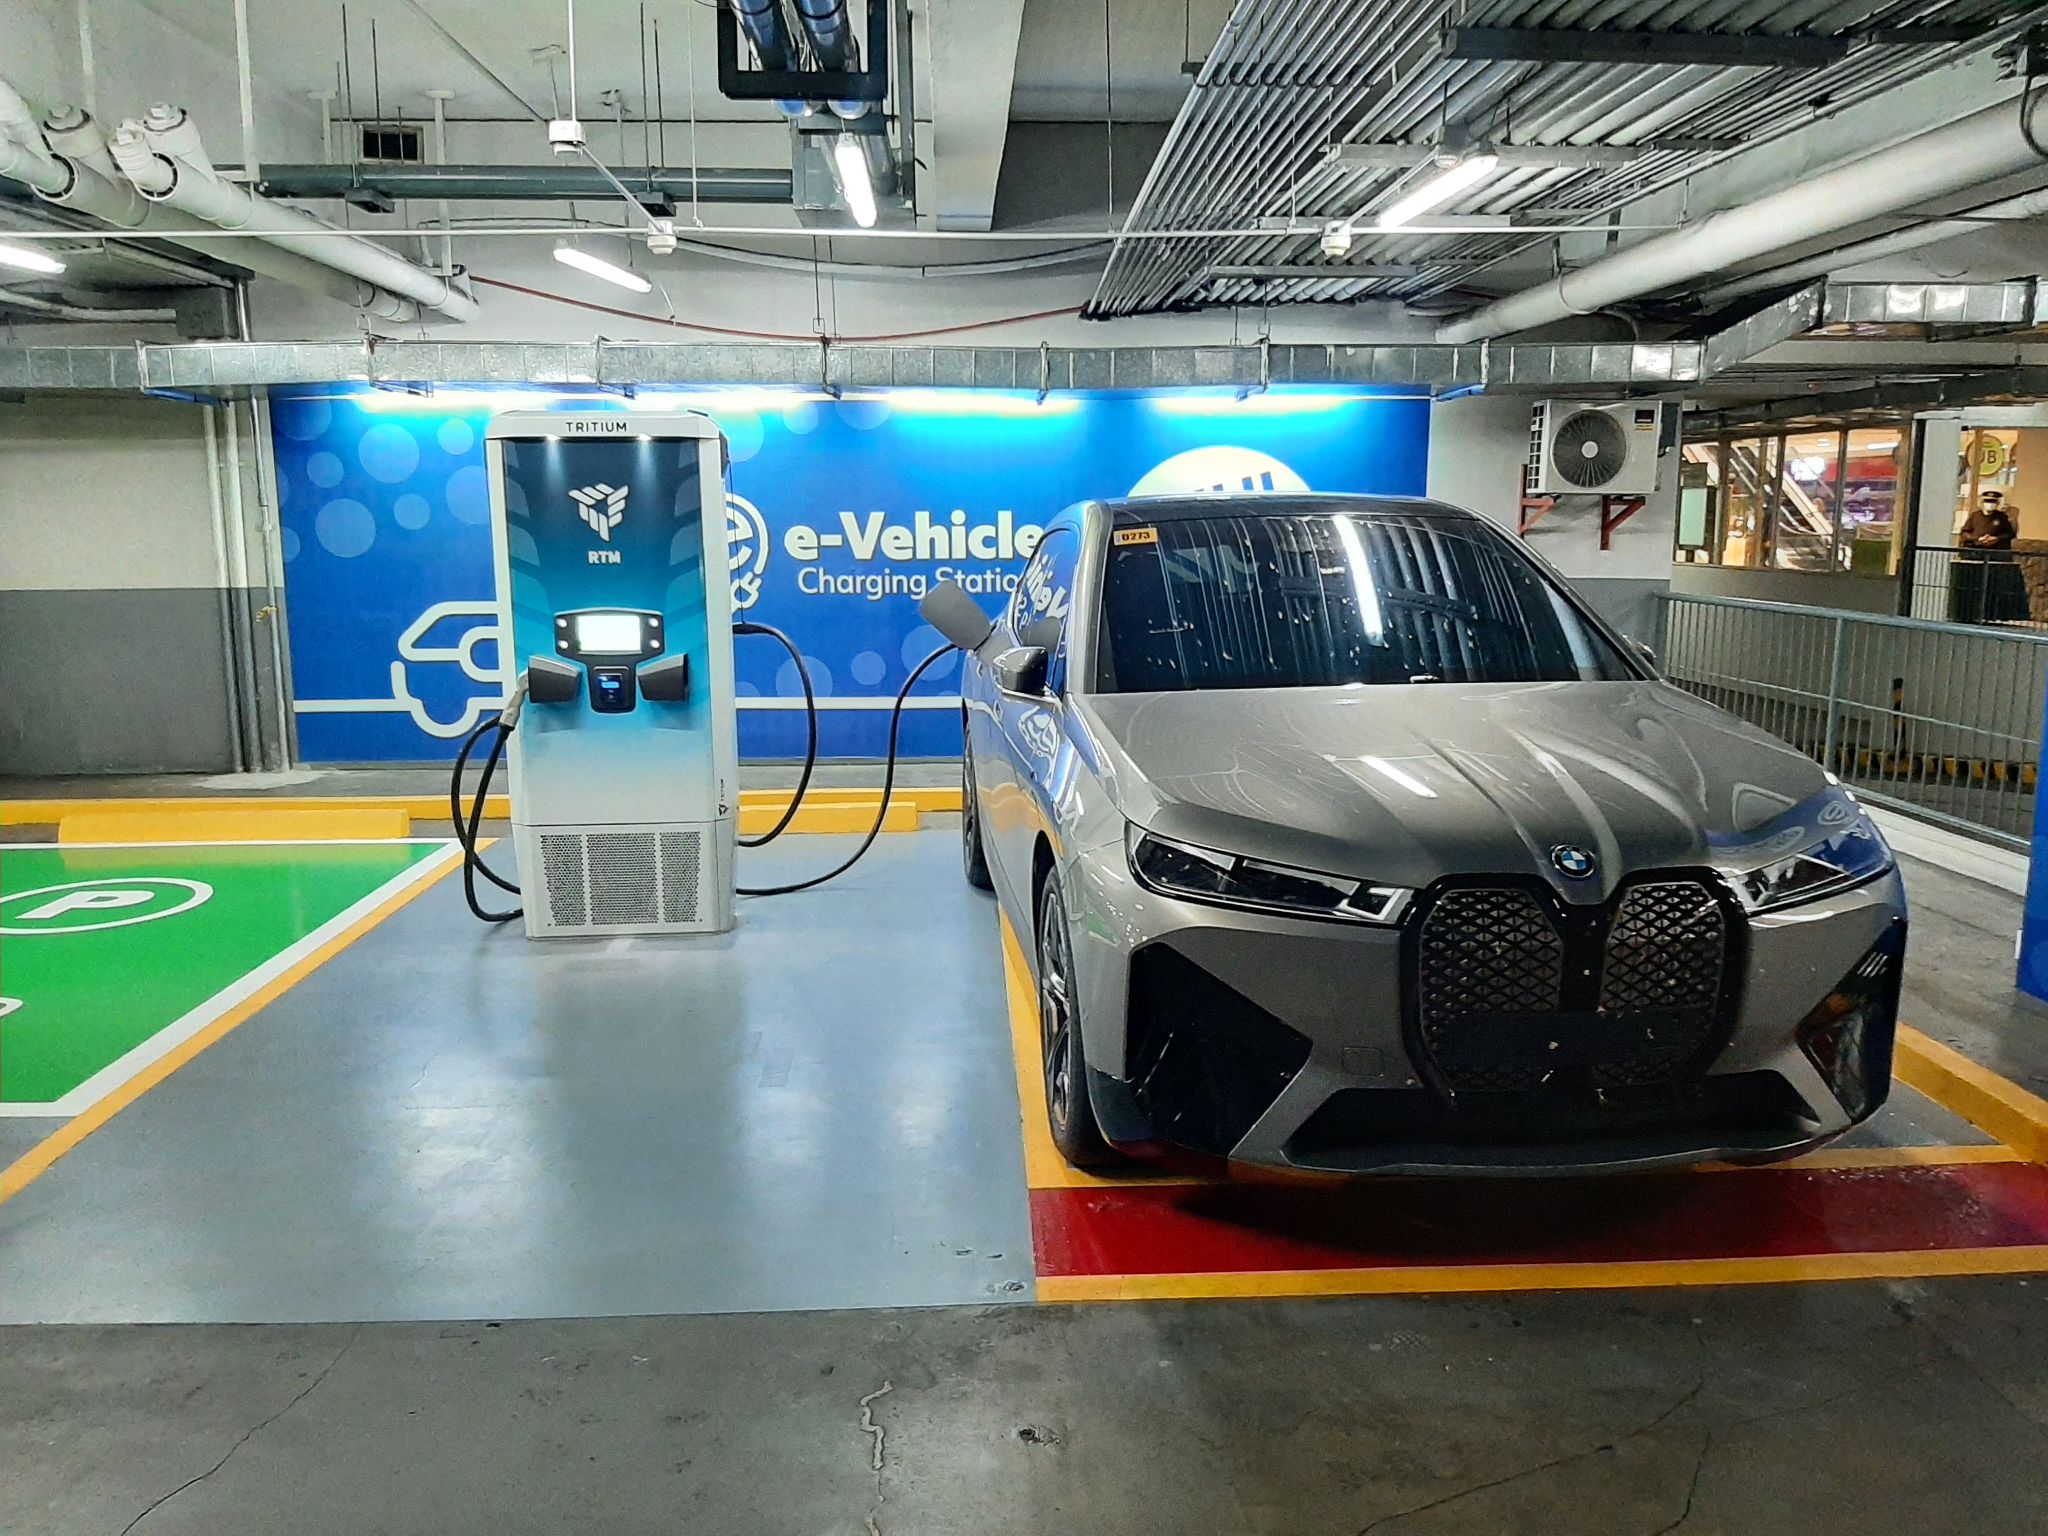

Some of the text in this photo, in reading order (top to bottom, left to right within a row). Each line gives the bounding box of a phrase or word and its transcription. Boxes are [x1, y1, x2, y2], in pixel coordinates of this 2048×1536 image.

[564, 421, 628, 433] TRITIUM
[784, 509, 1044, 560] e-Vehicle
[1121, 531, 1150, 541] 0273
[588, 550, 621, 564] RTM
[798, 567, 927, 600] Charging
[935, 566, 1020, 594] Statio
